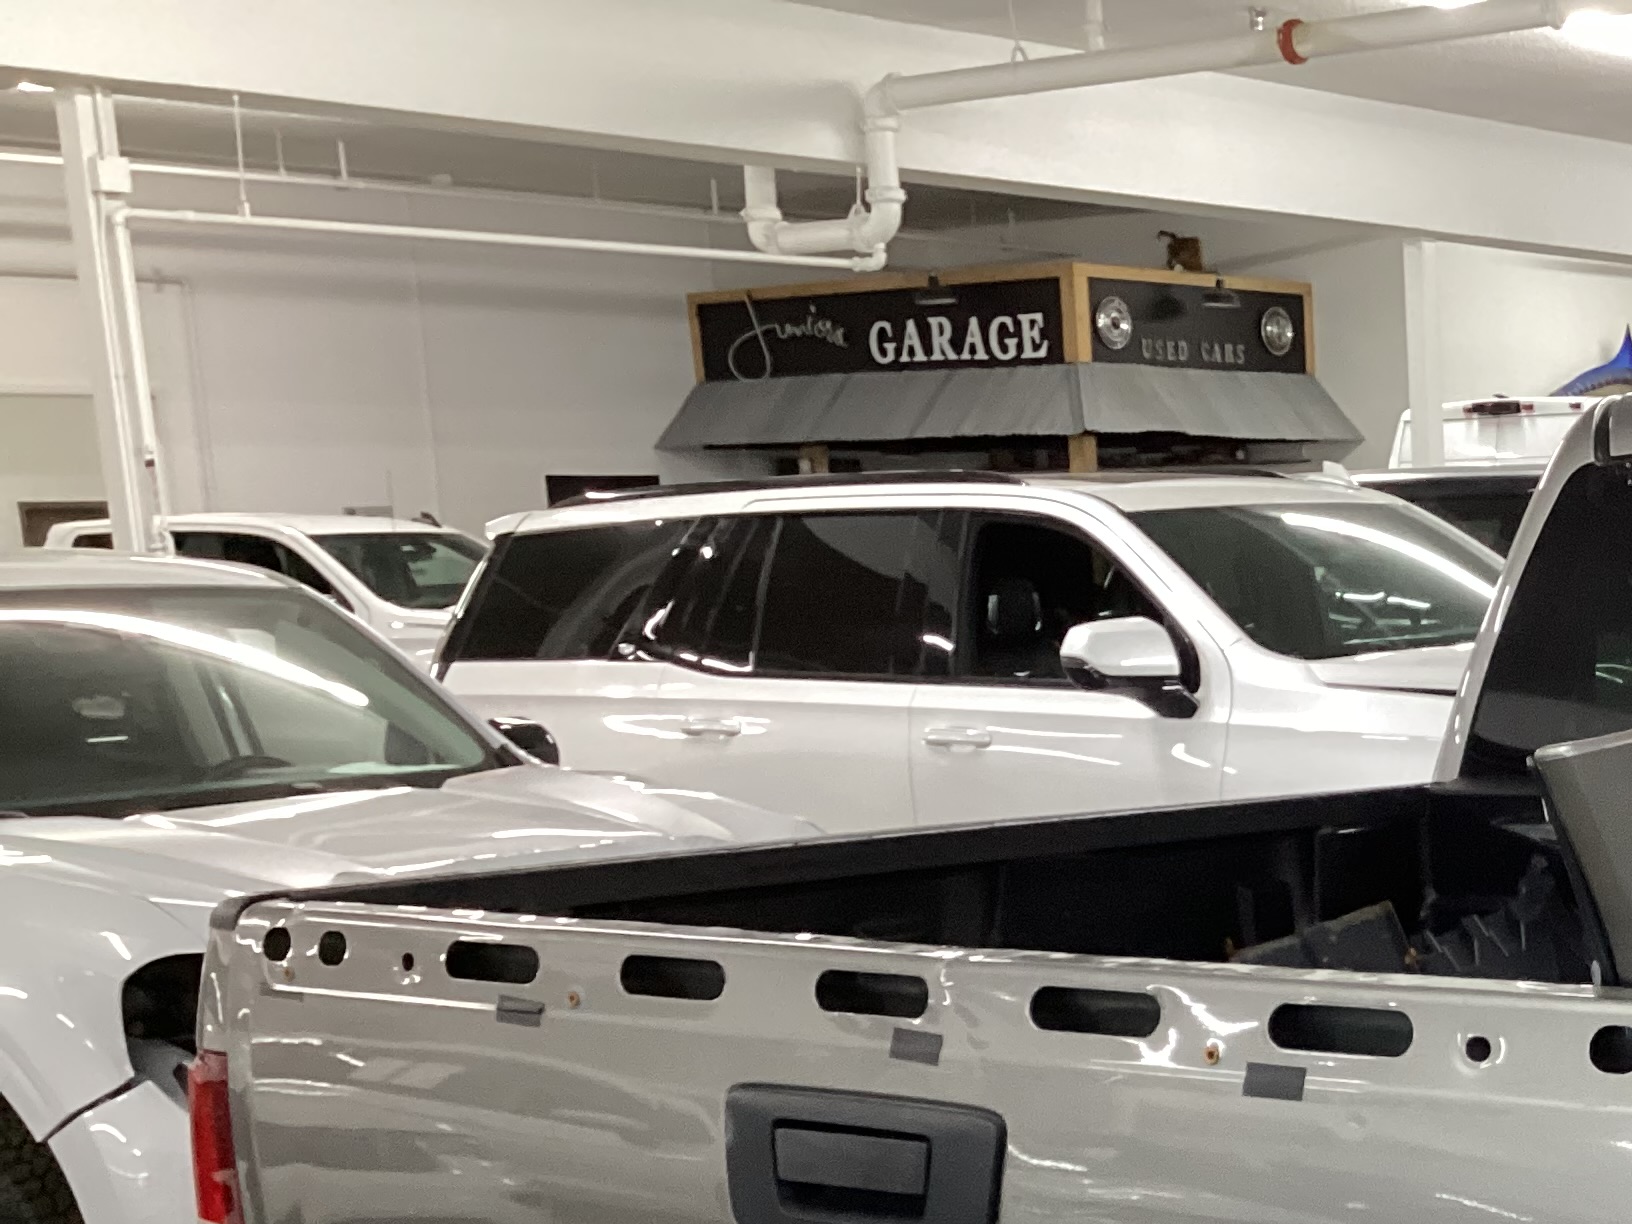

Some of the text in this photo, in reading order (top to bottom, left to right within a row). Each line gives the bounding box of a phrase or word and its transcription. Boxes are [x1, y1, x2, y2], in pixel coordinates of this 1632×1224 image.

[868, 312, 1049, 365] GARAGE
[1141, 336, 1246, 365] USED CARS
